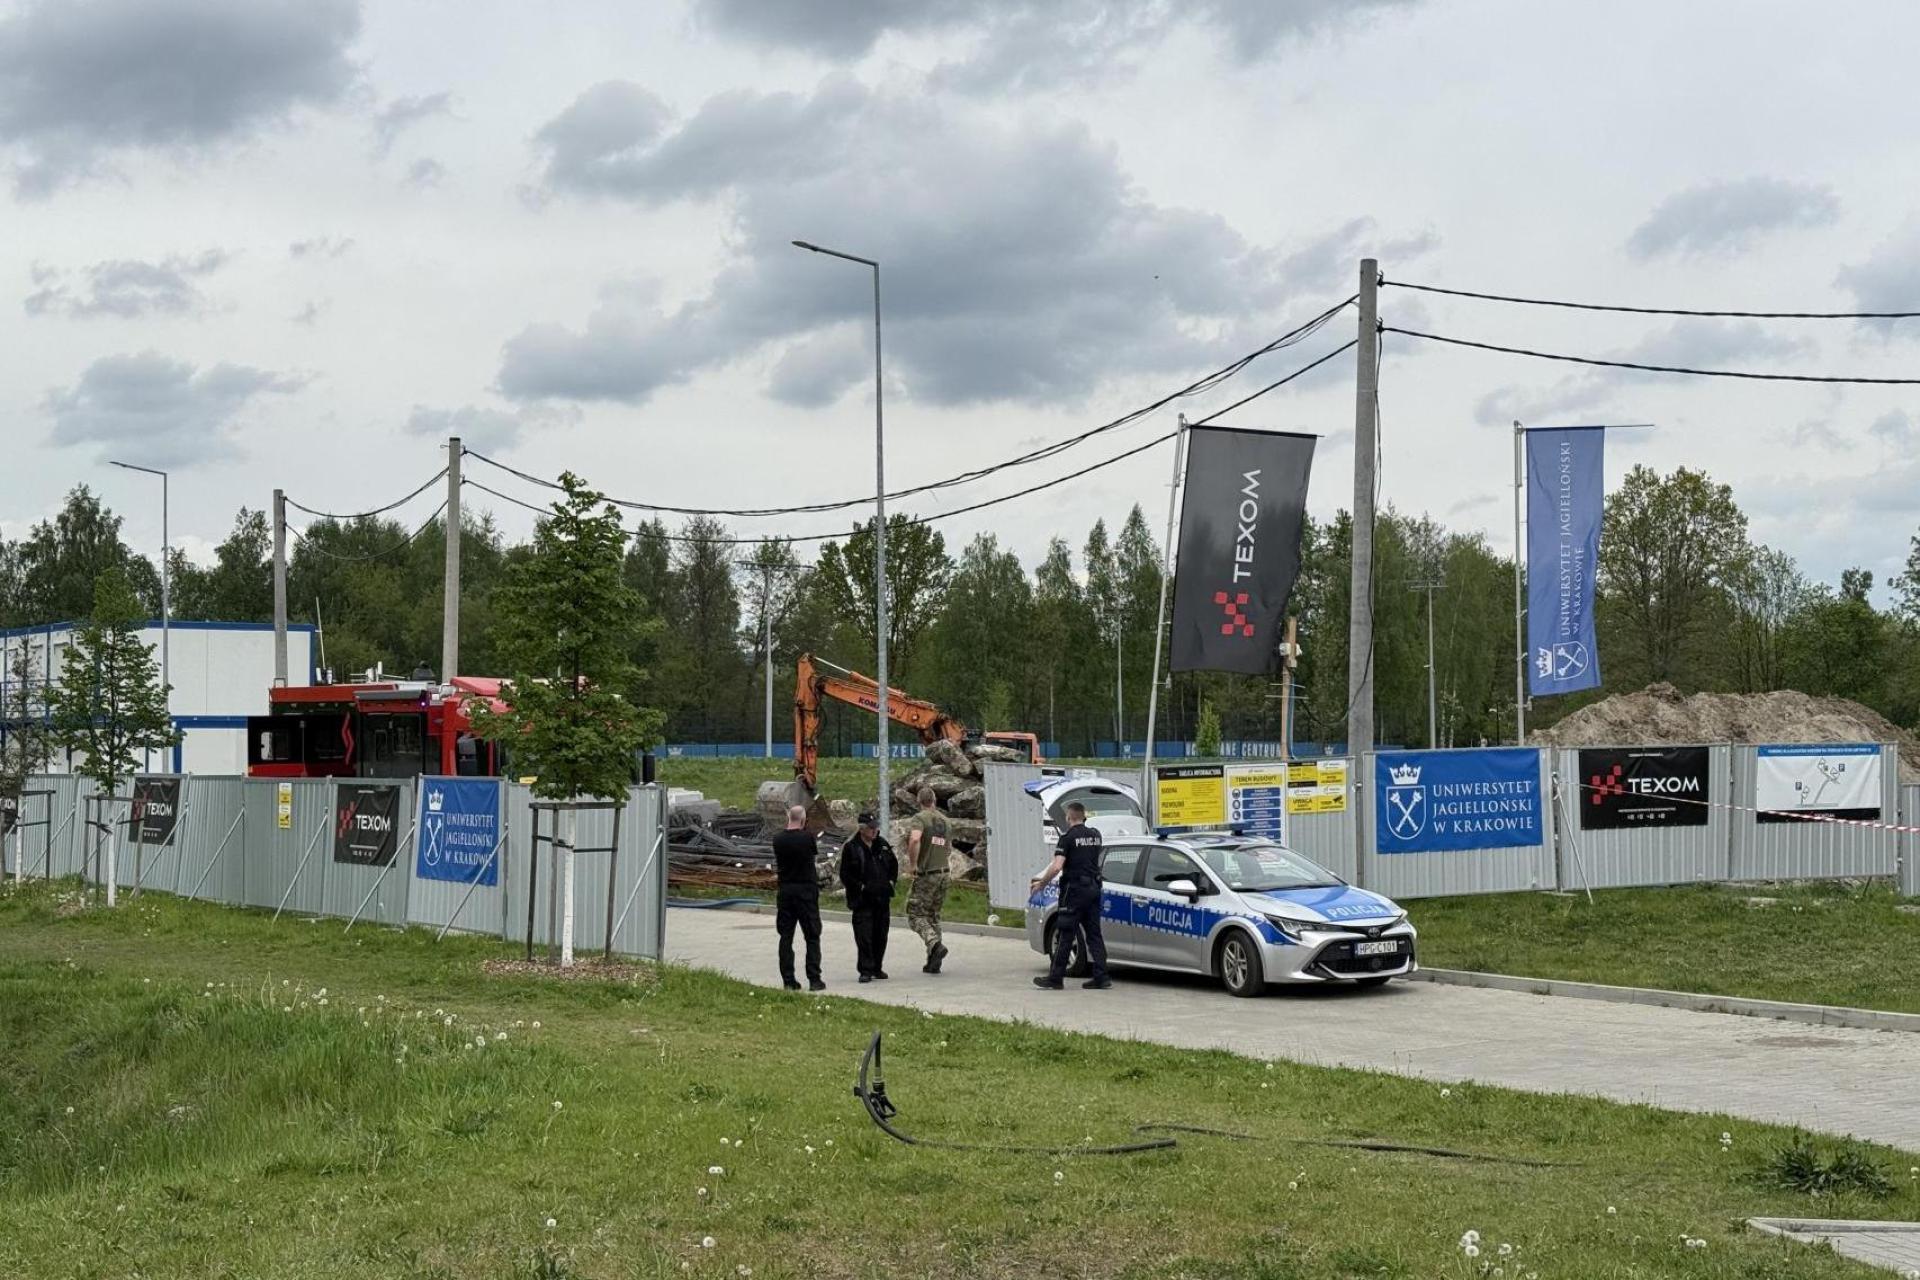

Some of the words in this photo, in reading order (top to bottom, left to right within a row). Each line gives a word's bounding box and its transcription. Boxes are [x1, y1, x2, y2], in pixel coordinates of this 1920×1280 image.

[1559, 442, 1571, 536] JAGIELLOŃSKI
[1233, 469, 1261, 583] TEXOM
[1560, 544, 1571, 636] UNIWERSYTET
[1433, 781, 1532, 797] UNIWERSYTET
[1628, 776, 1700, 793] TEXOM
[147, 802, 172, 816] TEXOM
[1433, 797, 1532, 818] JAGIELLOŃSKI
[355, 814, 391, 832] TEXOM
[446, 813, 494, 828] UNIWERSYTET
[1433, 821, 1446, 834] W
[1453, 817, 1533, 833] KRAKOWIE
[1075, 837, 1101, 847] POLICJA
[445, 851, 450, 863] W
[1148, 906, 1193, 931] POLICJA
[1326, 903, 1384, 918] POLICJA
[1360, 942, 1375, 953] HPG
[1377, 941, 1396, 953] C101
